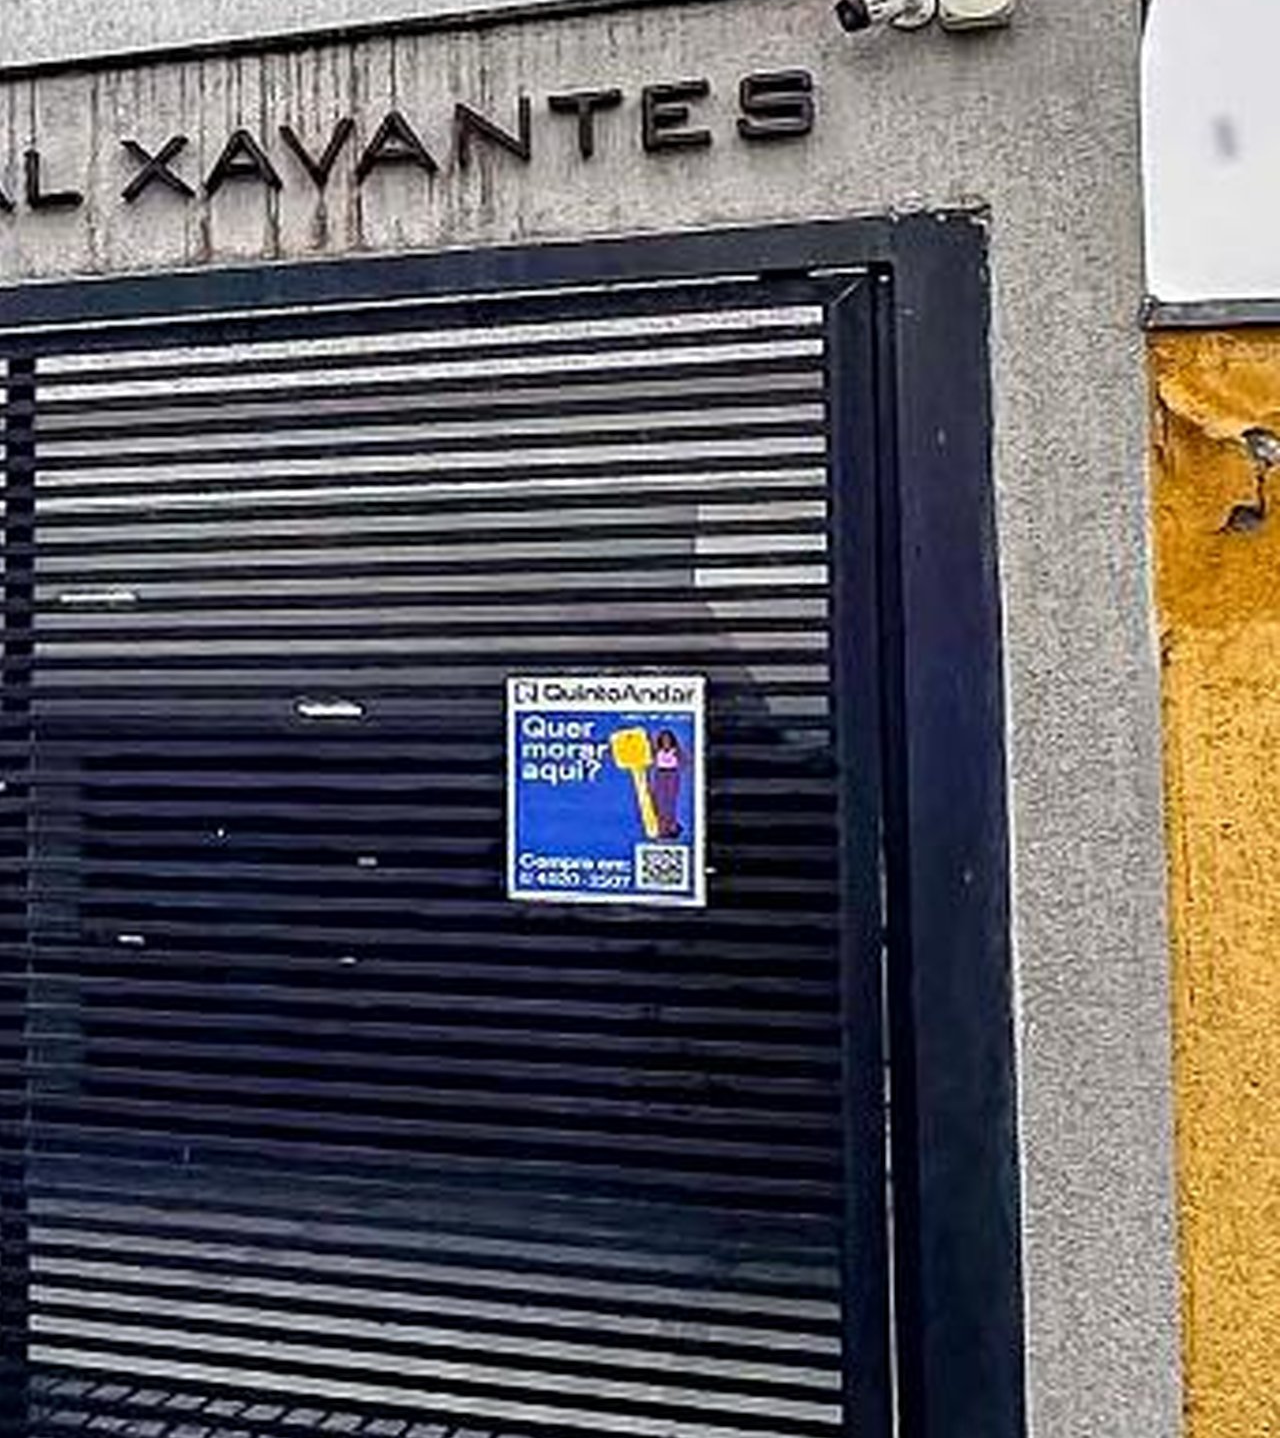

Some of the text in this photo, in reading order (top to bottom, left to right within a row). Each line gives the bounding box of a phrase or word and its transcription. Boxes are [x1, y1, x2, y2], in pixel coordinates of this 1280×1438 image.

[121, 68, 815, 202] XAVANTES
[542, 683, 696, 704] QuintoAndar
[521, 715, 596, 738] Quer
[521, 742, 608, 760] morar
[521, 760, 602, 785] aqui?
